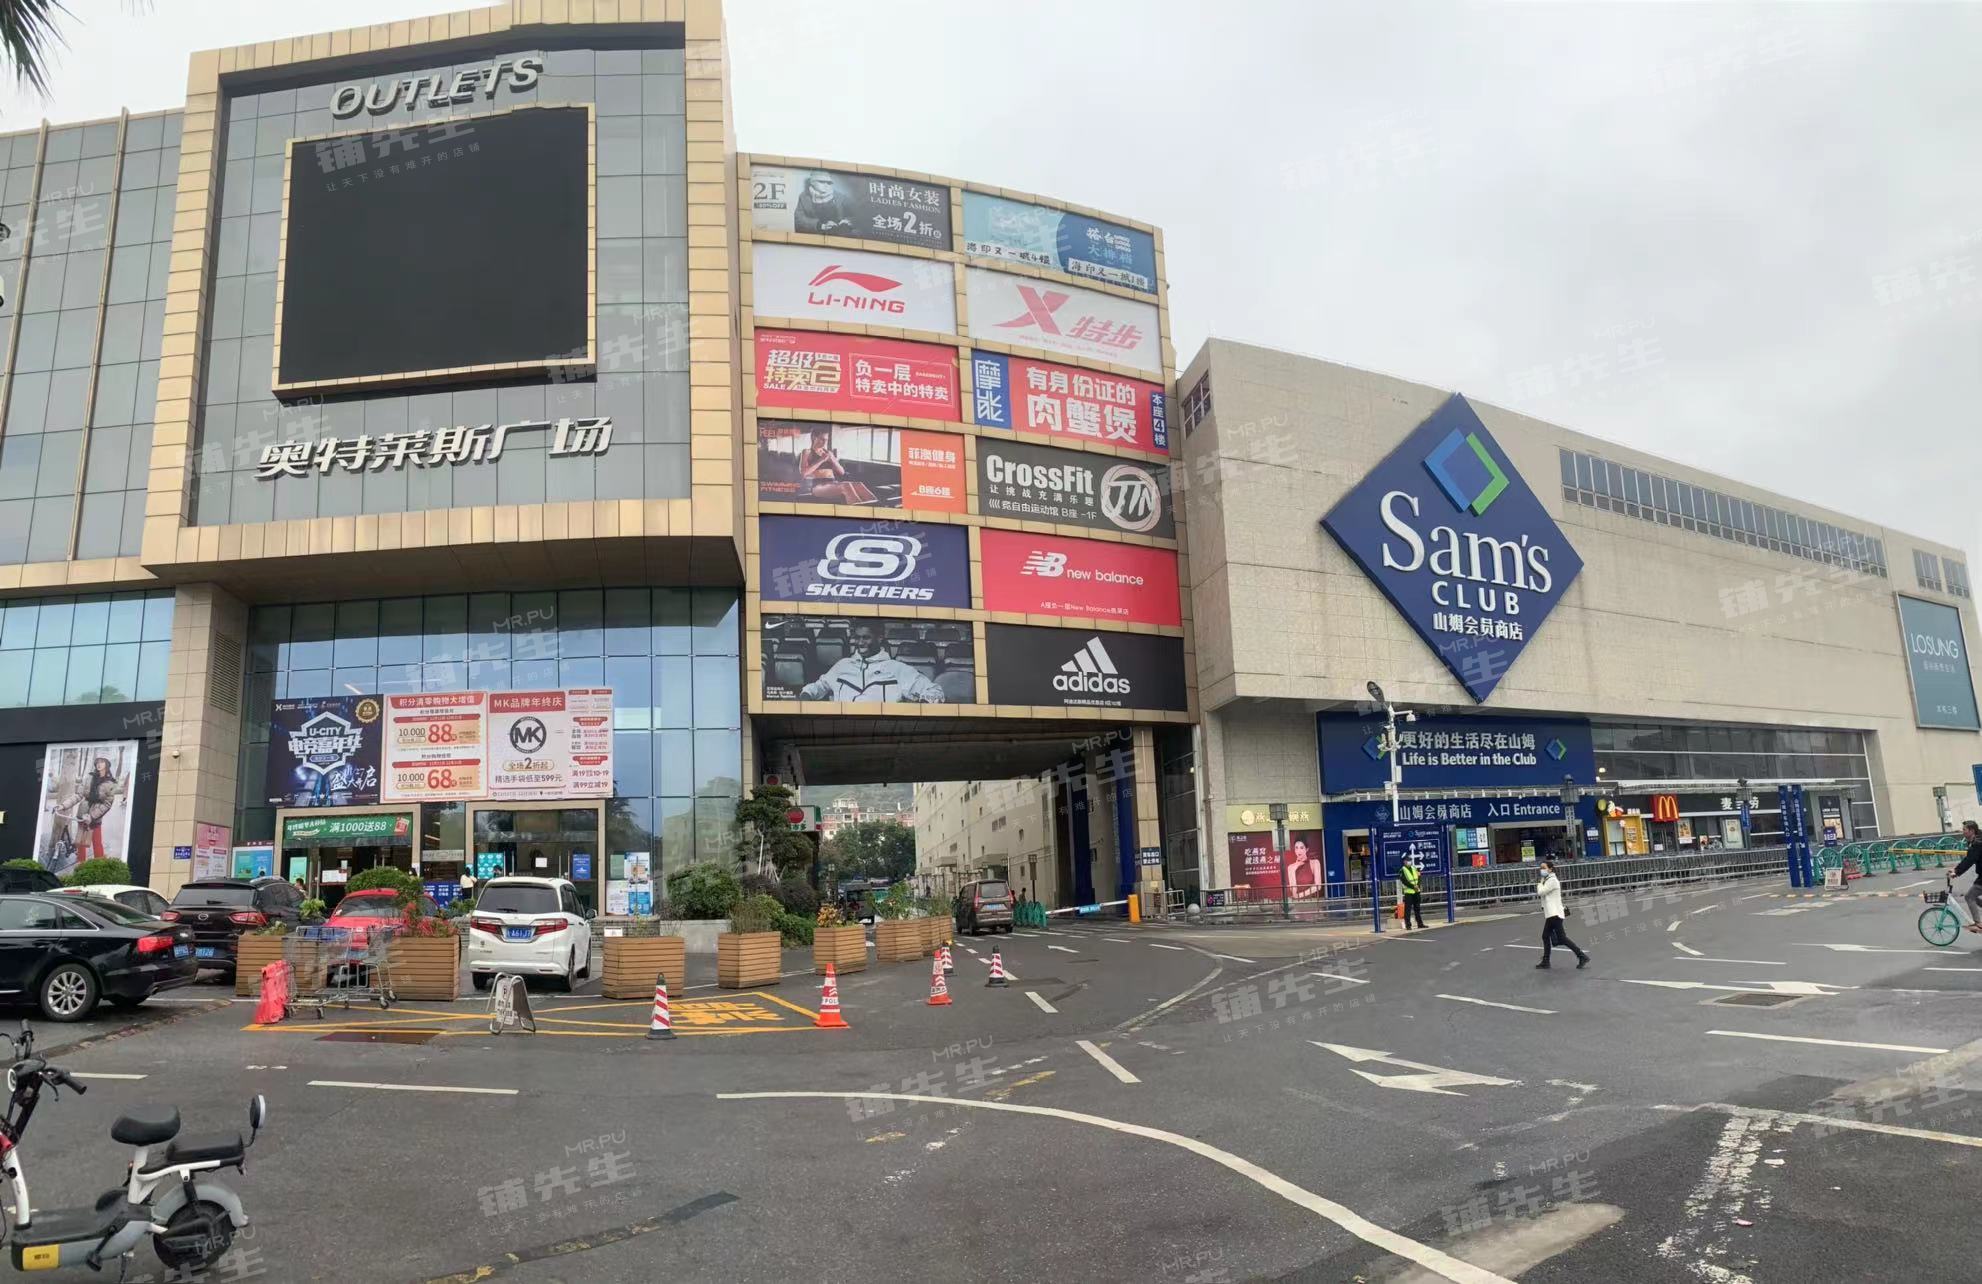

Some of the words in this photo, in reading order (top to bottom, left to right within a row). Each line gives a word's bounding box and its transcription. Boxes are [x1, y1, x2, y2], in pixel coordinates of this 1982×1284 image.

[330, 57, 544, 119] OUTLETS
[753, 182, 786, 200] 2F
[869, 182, 940, 206] 时尚女装
[870, 196, 902, 207] LADIES
[903, 200, 941, 214] FASHION
[807, 291, 906, 314] LI-NING
[1065, 315, 1144, 350] 特步
[767, 349, 814, 368] 超级
[855, 360, 911, 381] 负一层
[763, 382, 786, 391] SALE
[855, 379, 949, 400] 特卖中的特卖
[1026, 366, 1137, 406] 有身份证的
[1027, 394, 1138, 444] 肉蟹煲
[1151, 393, 1166, 446] 本座4楼
[254, 416, 614, 482] 奥特莱斯广场
[986, 454, 1094, 495] CrossFit
[989, 484, 1095, 507] 让挑战充满乐趣
[1380, 491, 1552, 594] Sam's
[1067, 569, 1092, 580] new
[1095, 569, 1144, 586] balance
[805, 583, 935, 601] SKECHERS
[1431, 581, 1520, 615] CLUB
[1433, 612, 1523, 641] 山姆会员商店
[1911, 633, 1959, 660] LOSUNG
[1052, 671, 1131, 694] adidas
[309, 727, 342, 736] U-CITY
[428, 723, 452, 743] 88
[1396, 731, 1536, 750] 更好的生活尽在山姆
[1402, 752, 1426, 766] Life
[1428, 753, 1439, 765] is
[1441, 752, 1477, 766] Better
[1480, 753, 1491, 766] in
[1493, 753, 1510, 766] the
[1513, 752, 1537, 766] Club
[428, 769, 452, 789] 68
[1400, 803, 1472, 821] 山姆会员商店
[1487, 803, 1510, 817] 入口
[1514, 803, 1560, 816] Entrance
[329, 821, 387, 833] 满1000送88
